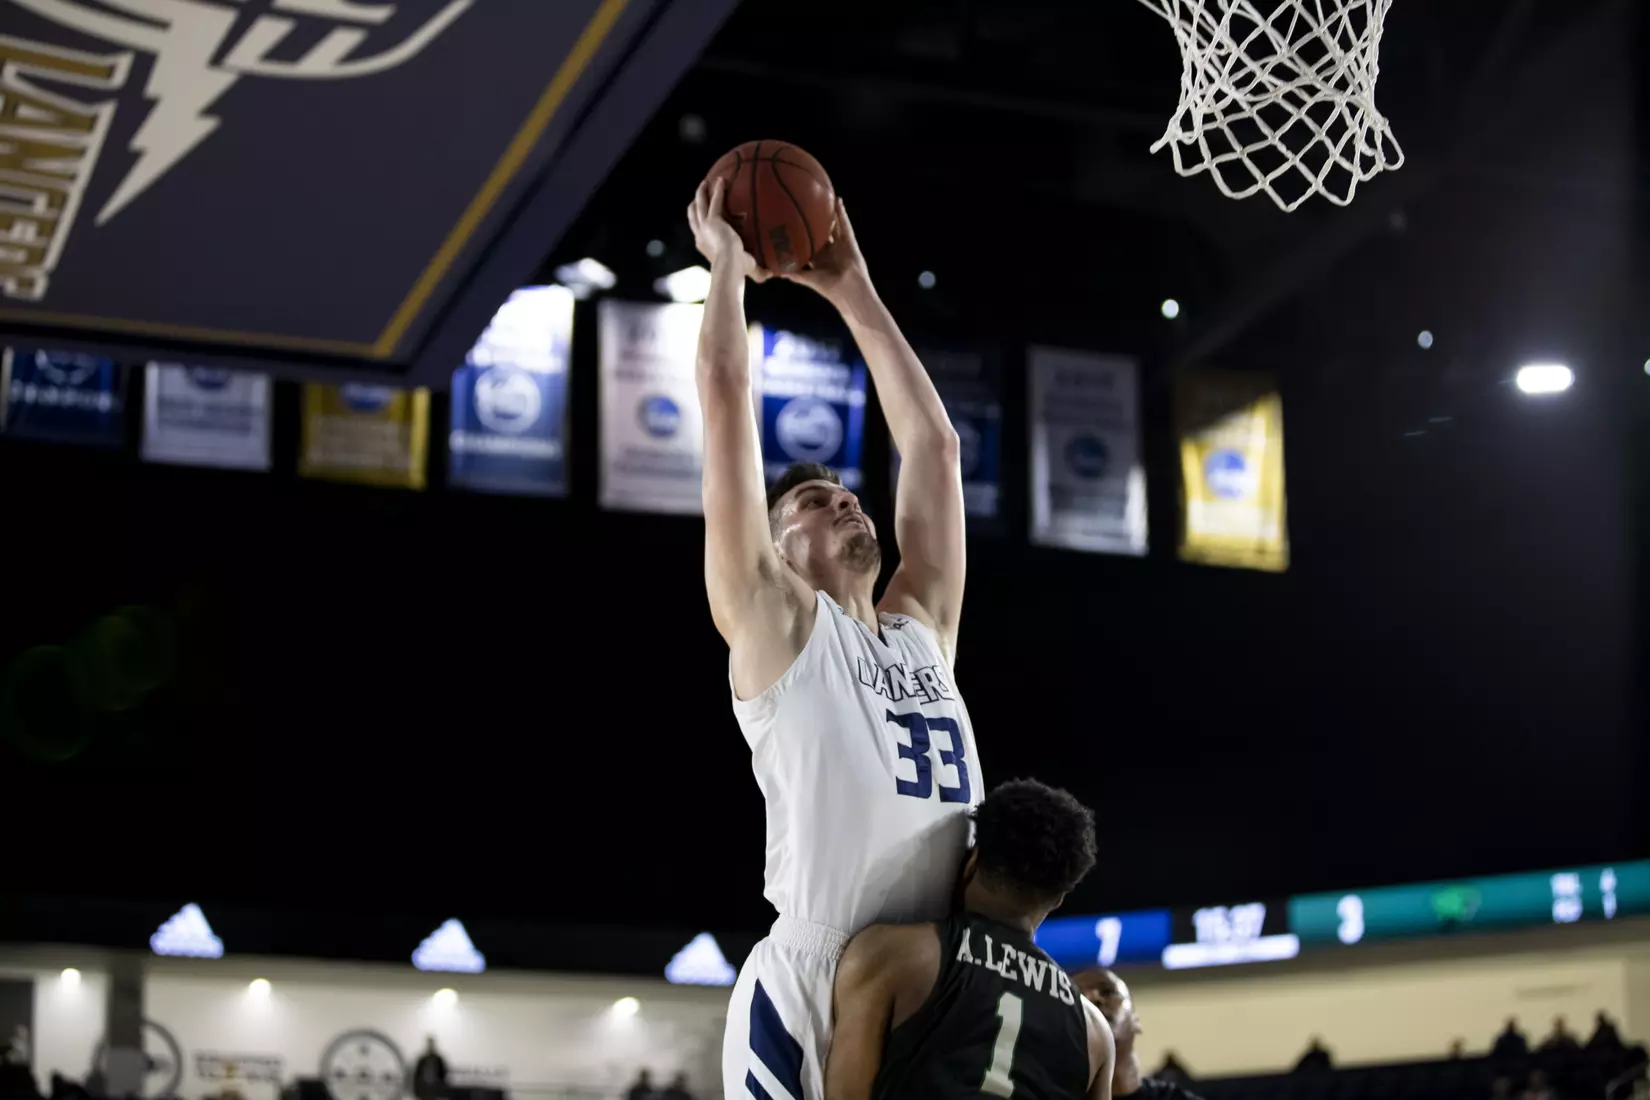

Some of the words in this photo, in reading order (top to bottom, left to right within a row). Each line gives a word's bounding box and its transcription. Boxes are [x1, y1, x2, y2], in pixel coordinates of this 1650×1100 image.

[886, 708, 970, 804] 33
[955, 926, 1076, 1006] A.LEWIS
[980, 991, 1024, 1099] 1
